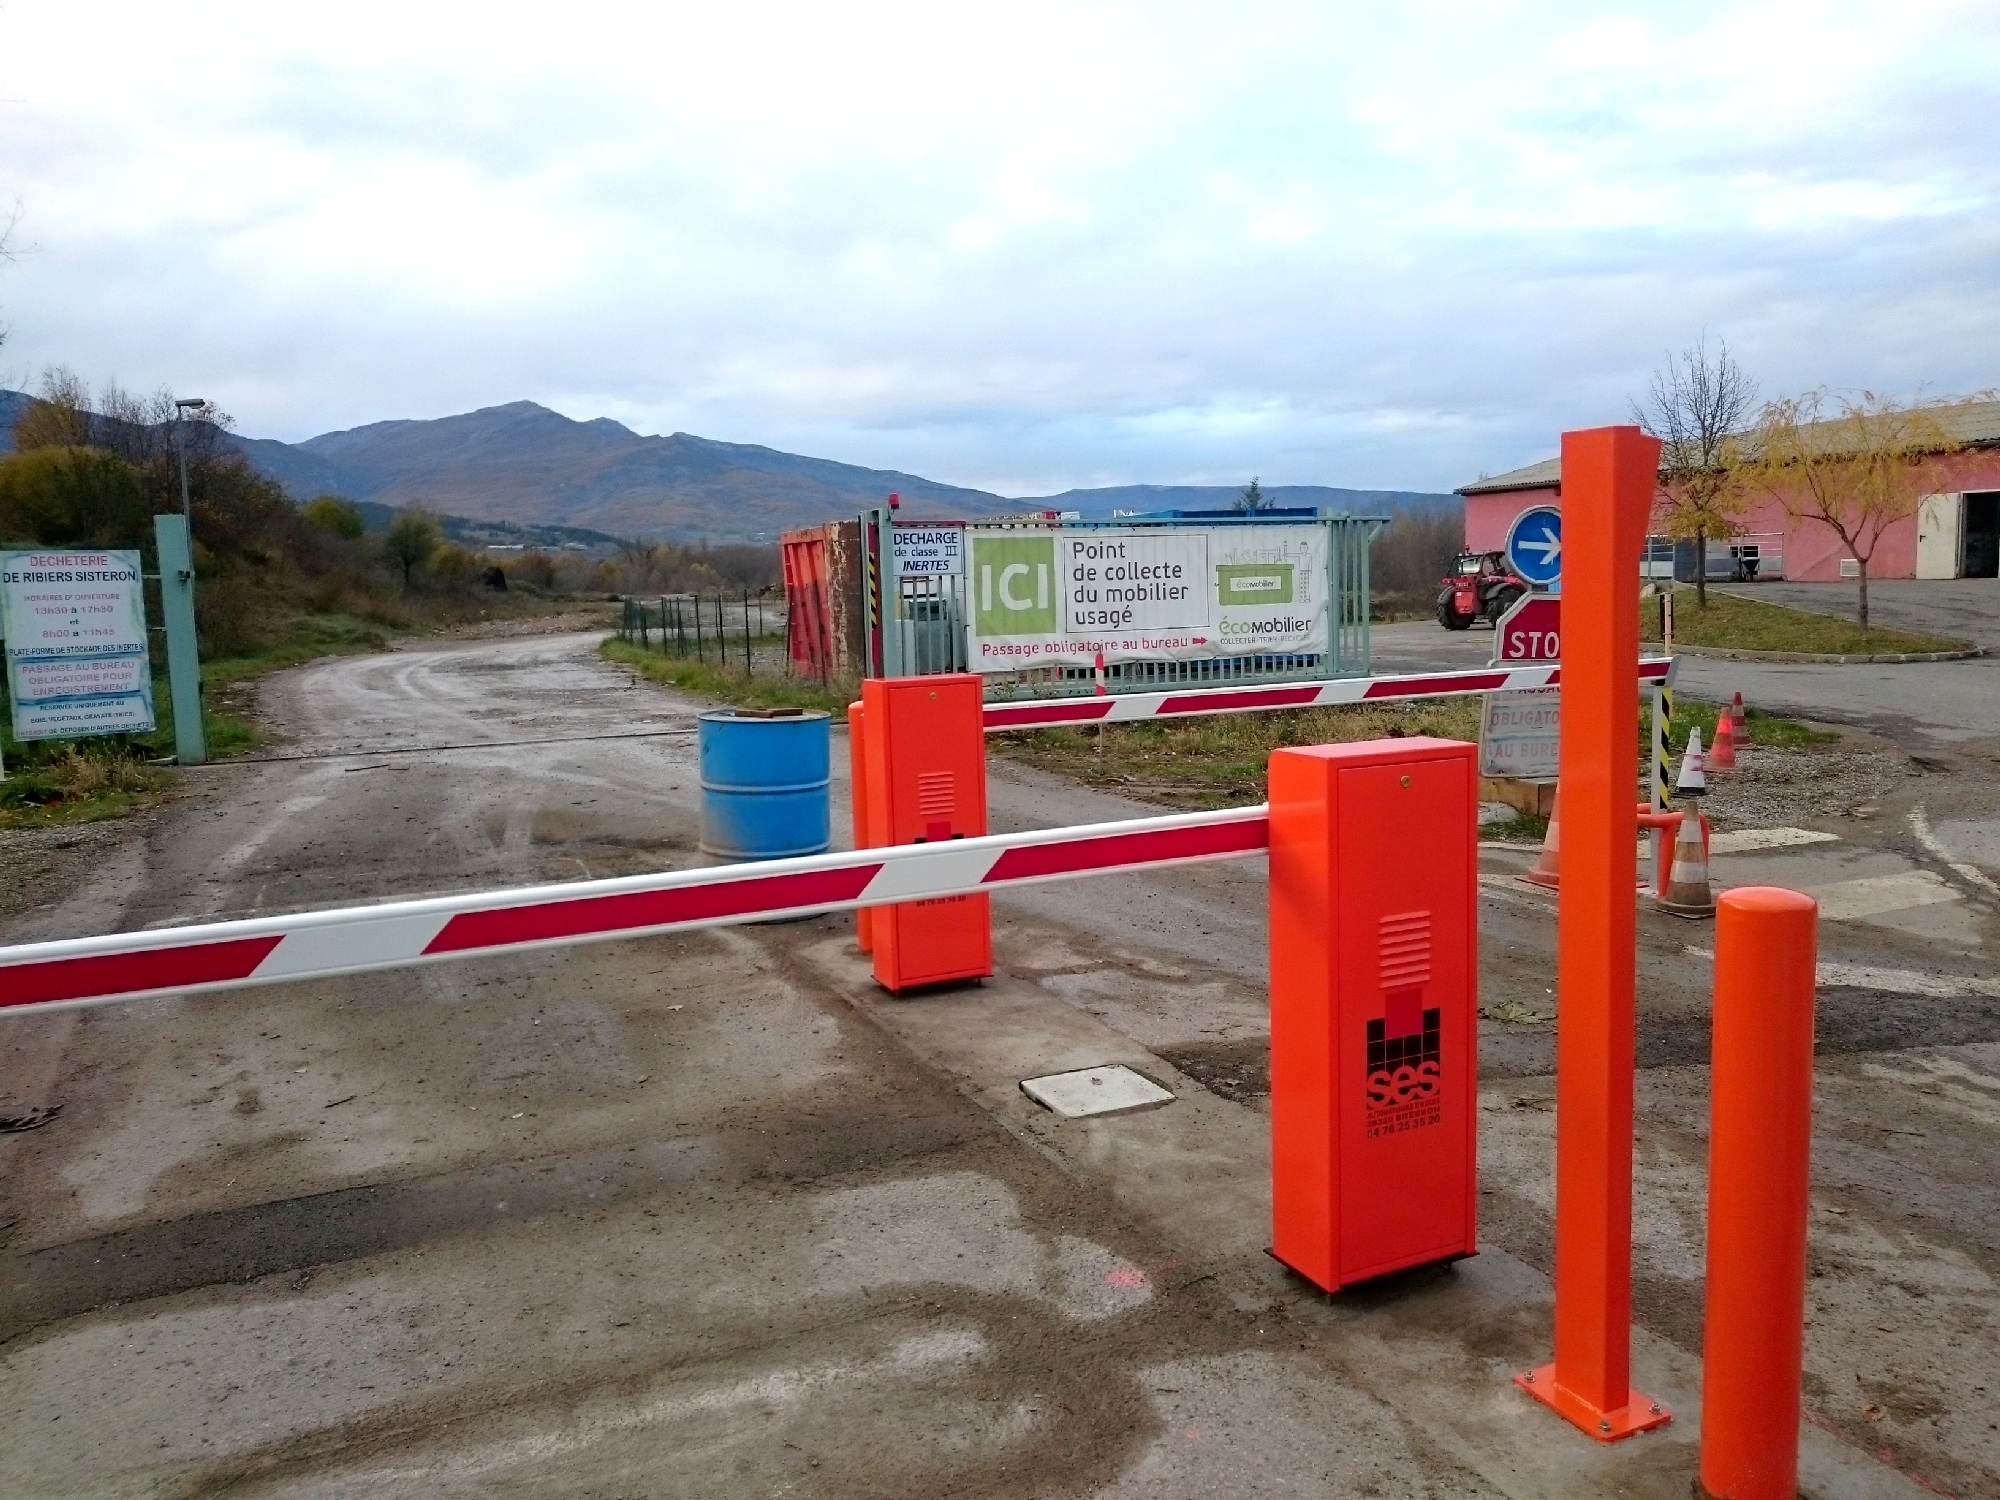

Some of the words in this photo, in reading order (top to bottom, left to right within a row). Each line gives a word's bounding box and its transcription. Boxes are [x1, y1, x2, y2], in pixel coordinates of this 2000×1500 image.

[893, 532, 958, 545] DECHARGE
[894, 546, 906, 556] de
[912, 546, 938, 556] classe
[1073, 541, 1126, 559] Point
[30, 556, 108, 566] DECHETERIE
[902, 560, 950, 572] INERTES
[4, 572, 20, 583] DE
[23, 572, 72, 582] RIBIERS
[76, 570, 136, 582] SISTERON
[1073, 564, 1097, 581] de
[1105, 562, 1182, 580] collecte
[982, 563, 1048, 611] ICI
[1074, 585, 1098, 603] du
[1106, 582, 1188, 602] mobilier
[35, 606, 68, 614] 13h30
[81, 606, 114, 614] 17h30
[1075, 604, 1132, 629] usagé
[10, 648, 55, 656] PLATE-FORME
[66, 645, 101, 653] STOCKAGE
[982, 643, 1039, 657] Passage
[1044, 639, 1118, 656] obligatoire
[1122, 640, 1138, 650] au
[1142, 637, 1188, 650] bureau
[1508, 631, 1560, 658] STO
[22, 664, 73, 674] PASSAGE
[92, 662, 134, 670] BUREAU
[28, 673, 100, 684] OBLIGATOIRE
[103, 672, 132, 680] POUR
[33, 683, 130, 696] ENREGISTREMENT
[1491, 710, 1560, 726] OBLIGATO
[1494, 744, 1514, 758] AU
[1520, 742, 1558, 757] BURE
[1366, 1060, 1440, 1110] ses
[1396, 1106, 1440, 1122] BRESSON
[1367, 1128, 1380, 1138] 04
[1382, 1124, 1395, 1135] 76
[1398, 1121, 1410, 1132] 25
[1413, 1118, 1426, 1128] 35
[1428, 1114, 1440, 1124] 20
